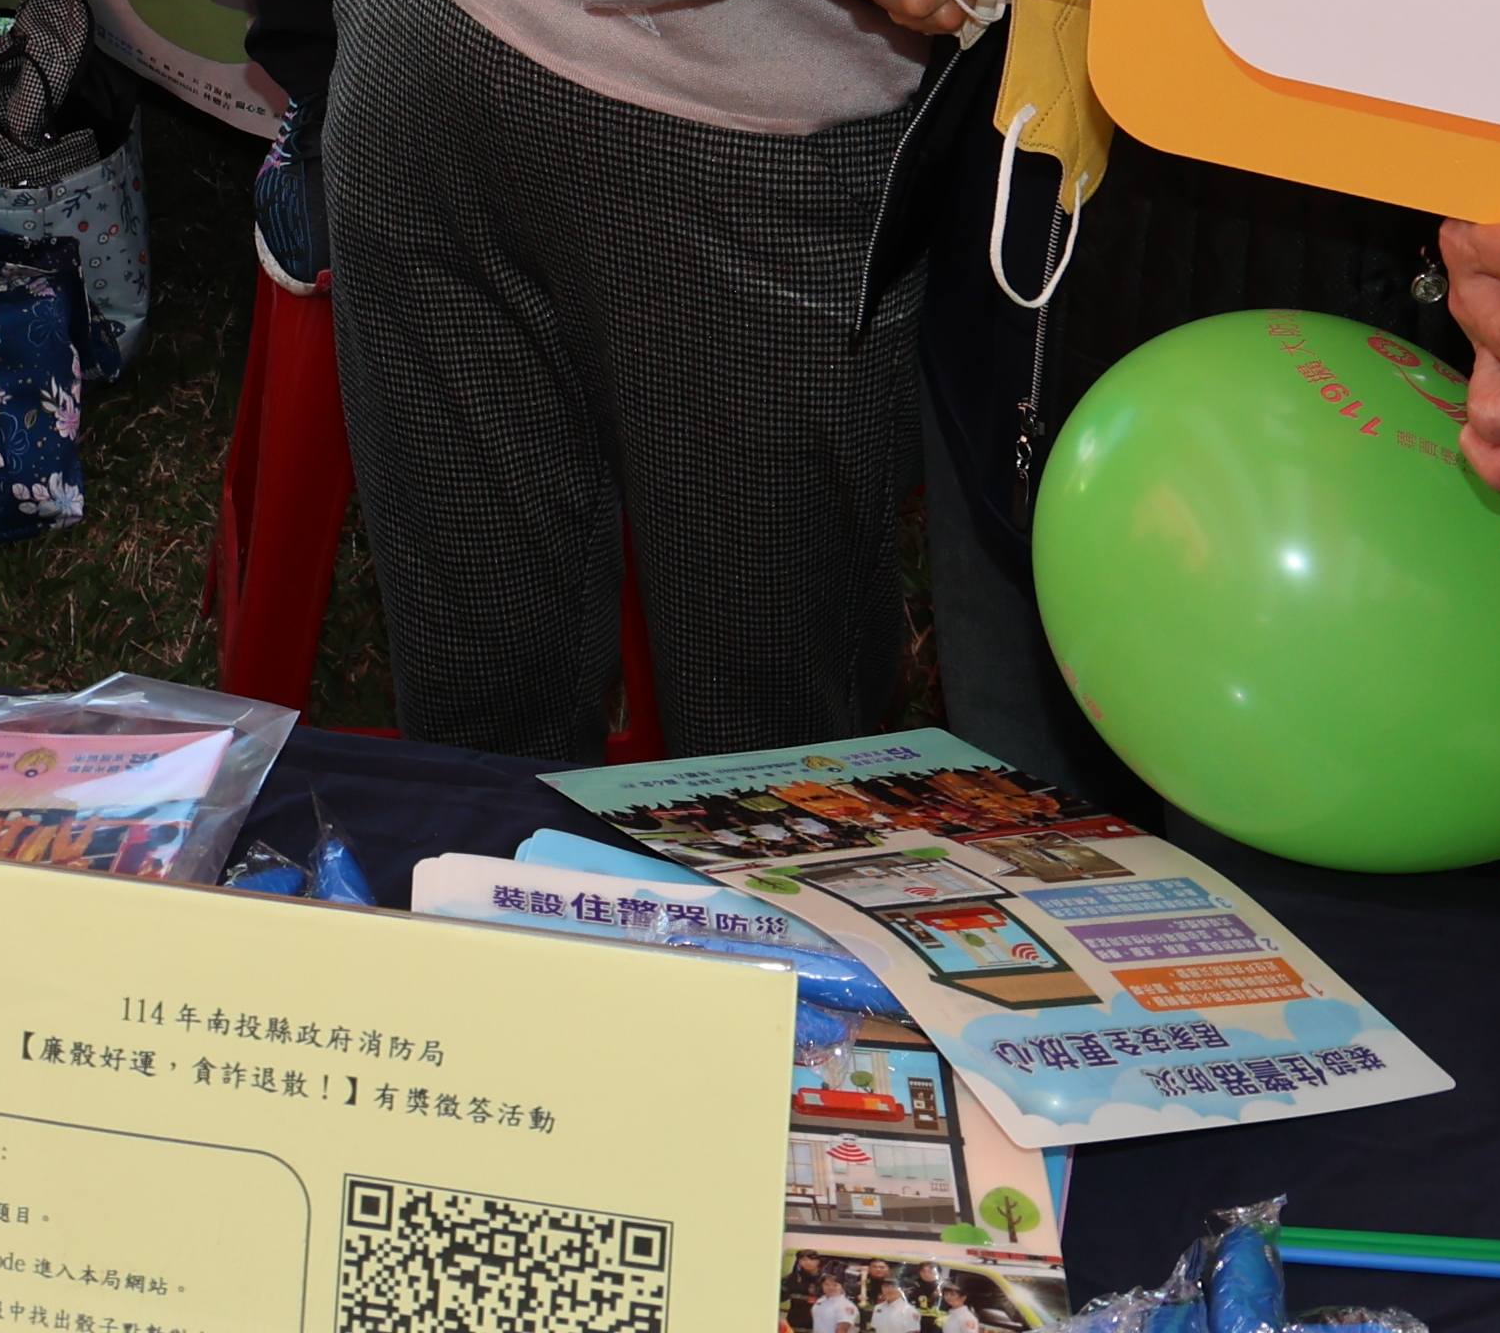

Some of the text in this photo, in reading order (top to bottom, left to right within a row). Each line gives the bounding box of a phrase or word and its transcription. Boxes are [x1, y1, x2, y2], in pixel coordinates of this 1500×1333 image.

[121, 996, 166, 1027] 114
[990, 1020, 1232, 1075] 居家安全更放心
[1138, 1044, 1388, 1099] 裝設住警器防災
